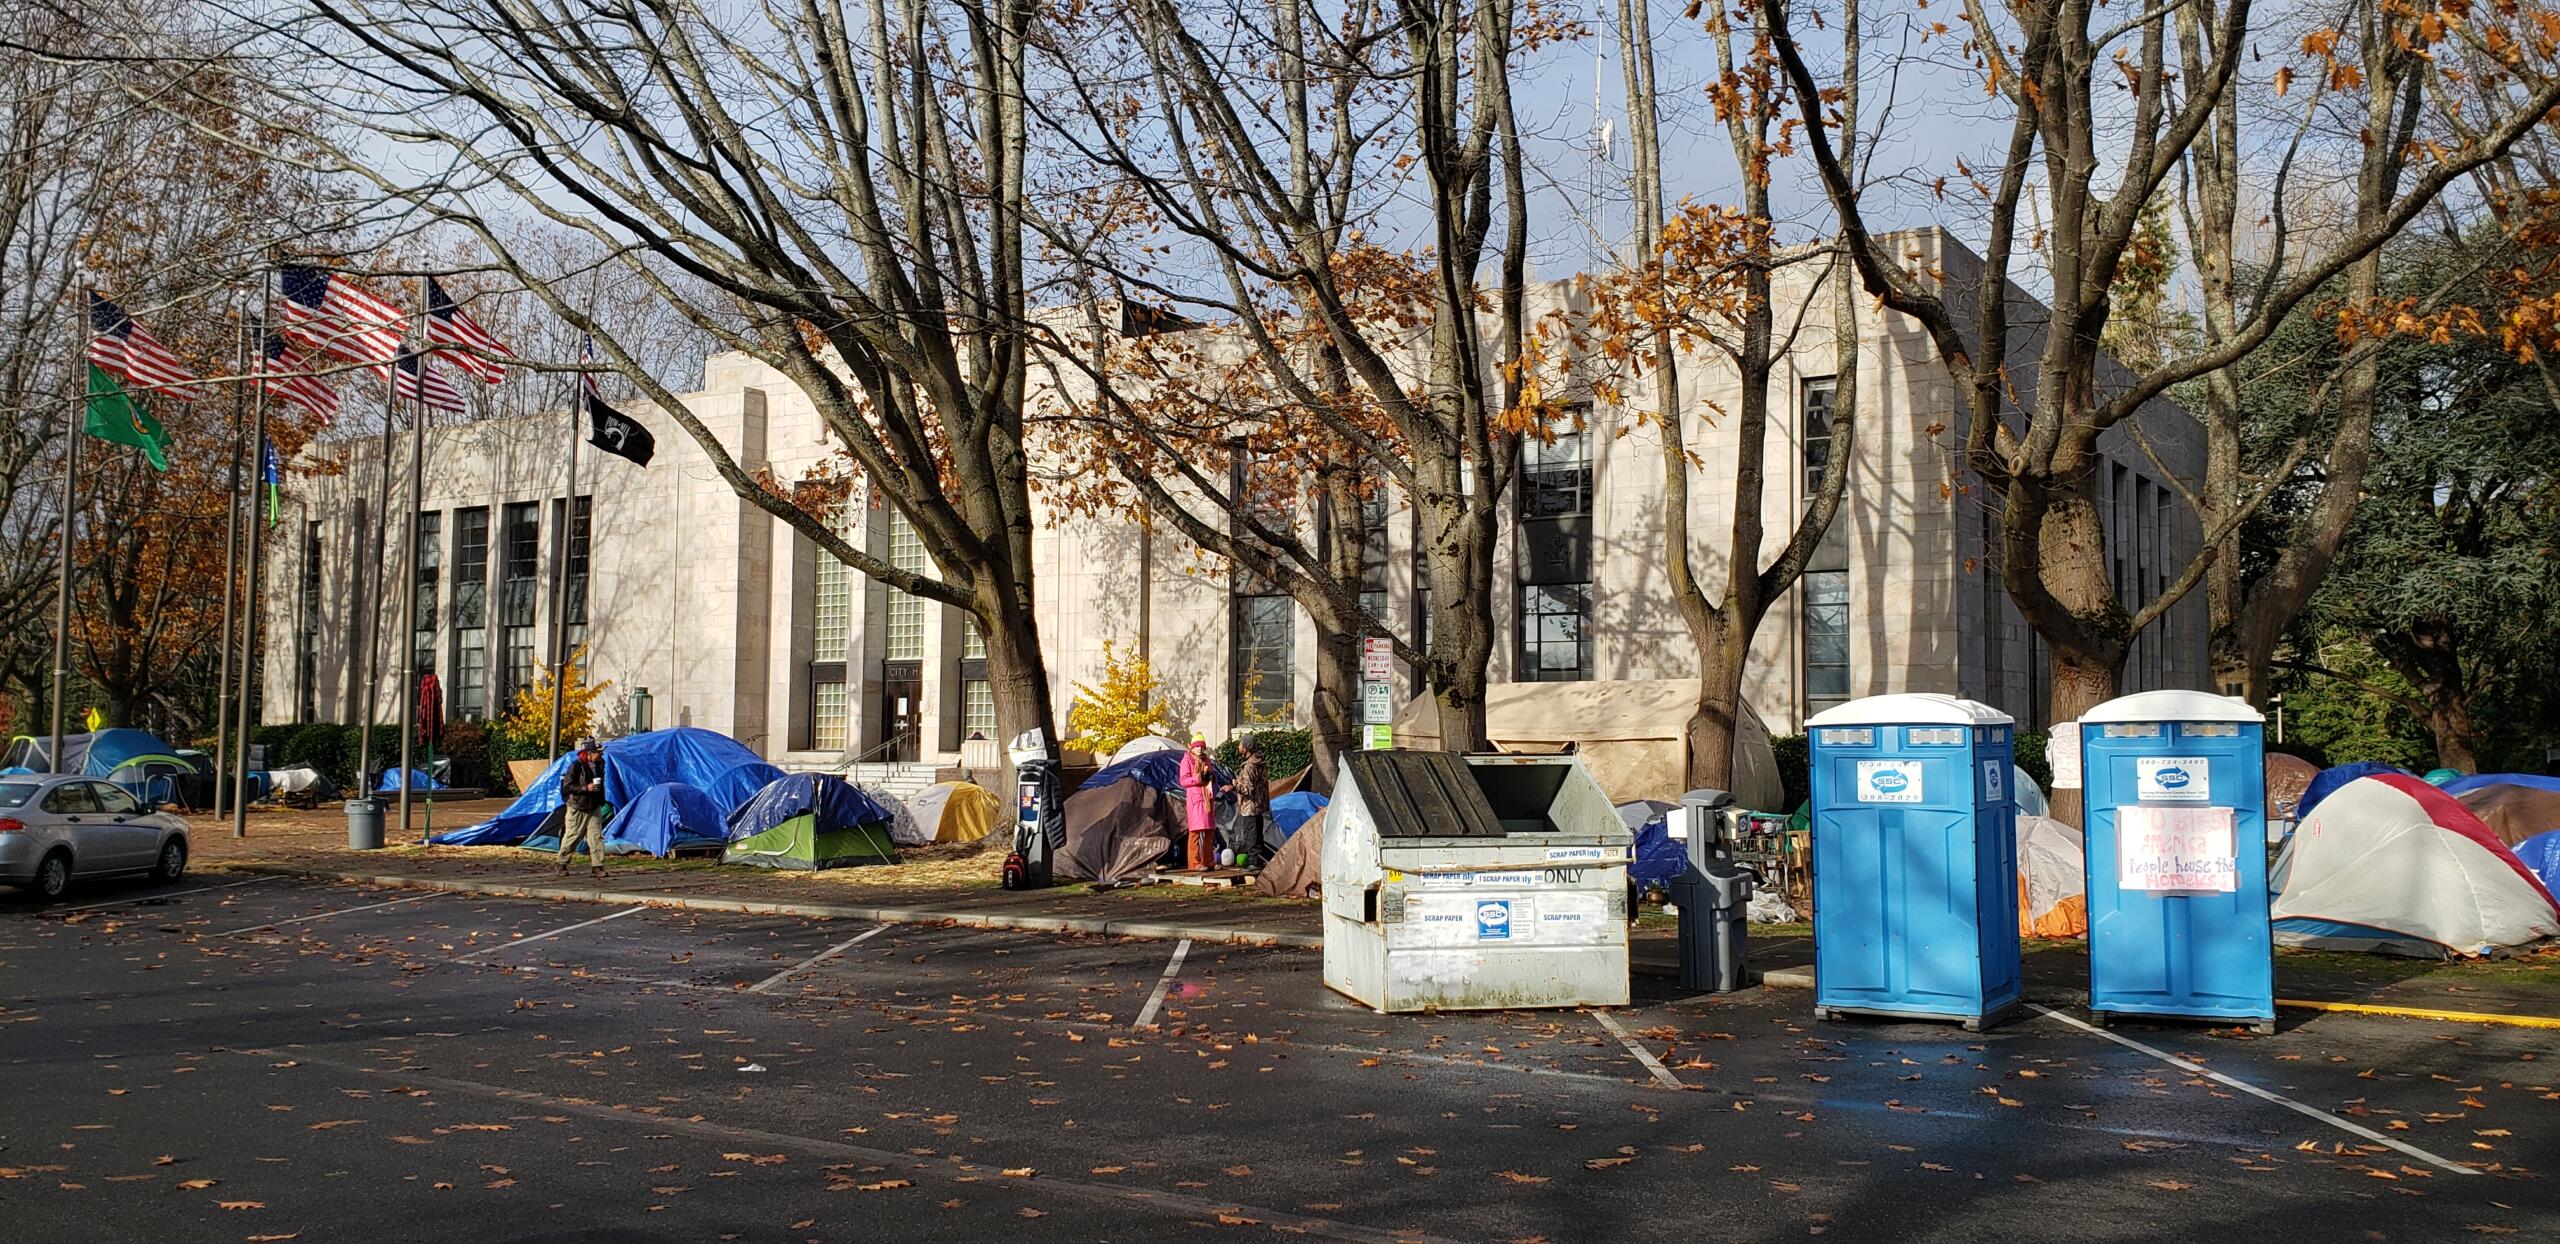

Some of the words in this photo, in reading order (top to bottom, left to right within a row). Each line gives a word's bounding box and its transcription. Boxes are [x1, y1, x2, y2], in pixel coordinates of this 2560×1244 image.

[889, 667, 909, 677] CITY
[1549, 851, 1568, 859] SCRAP
[1568, 849, 1587, 857] PAPER
[2129, 856, 2169, 874] People
[2174, 856, 2211, 874] house
[2214, 857, 2235, 873] the
[1422, 872, 1442, 880] SCRAP
[1442, 872, 1461, 880] PAPER
[1544, 868, 1585, 884] ONLY
[1444, 914, 1463, 922] PAPER
